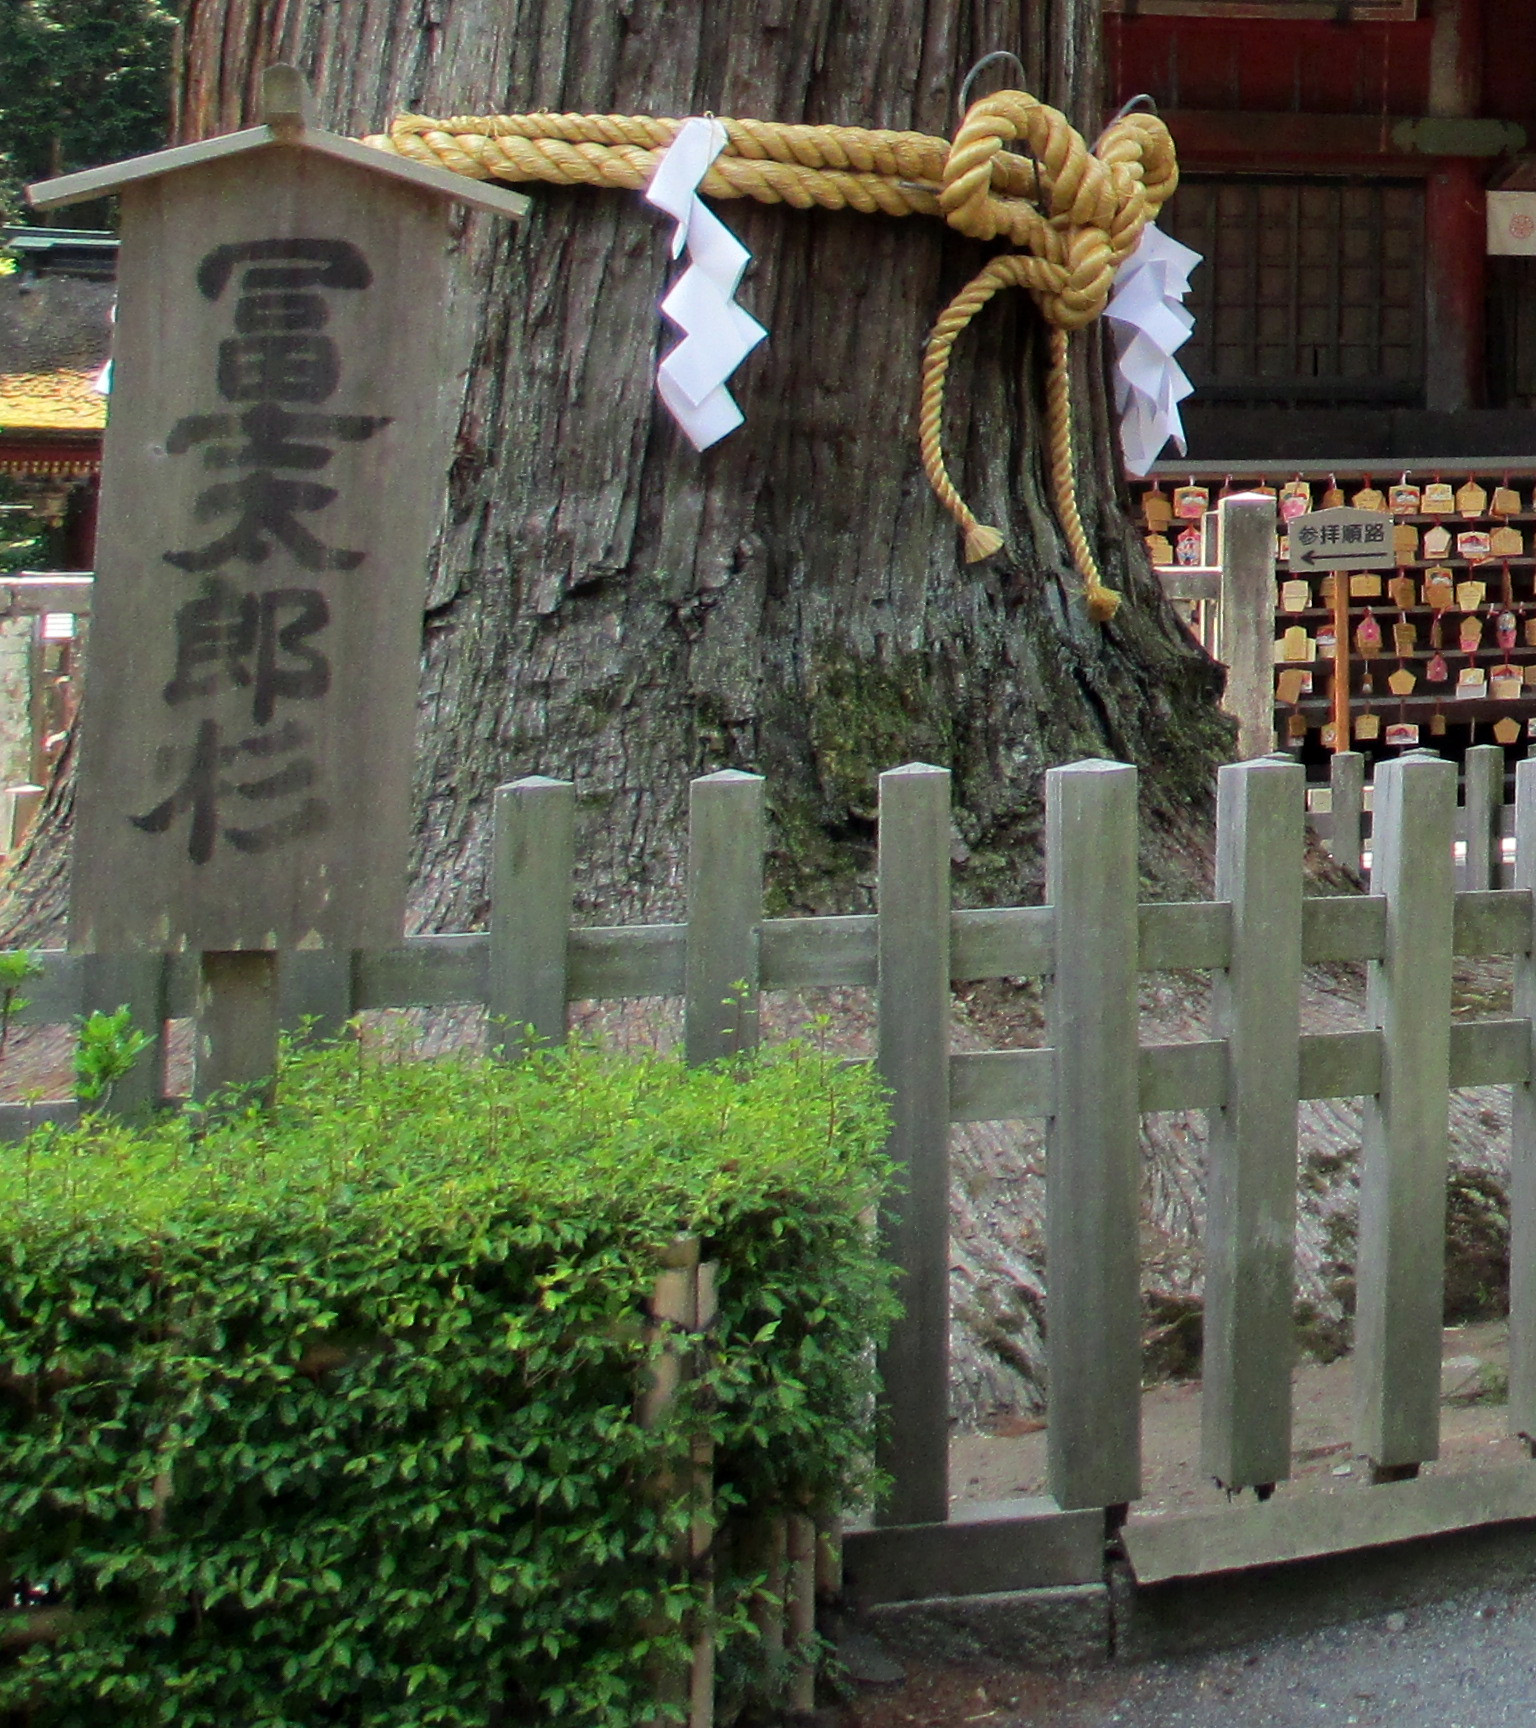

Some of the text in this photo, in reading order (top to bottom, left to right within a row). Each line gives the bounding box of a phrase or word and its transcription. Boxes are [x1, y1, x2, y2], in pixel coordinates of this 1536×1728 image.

[129, 237, 391, 867] 冨士太郎杉
[1298, 522, 1385, 546] 参拝順路
